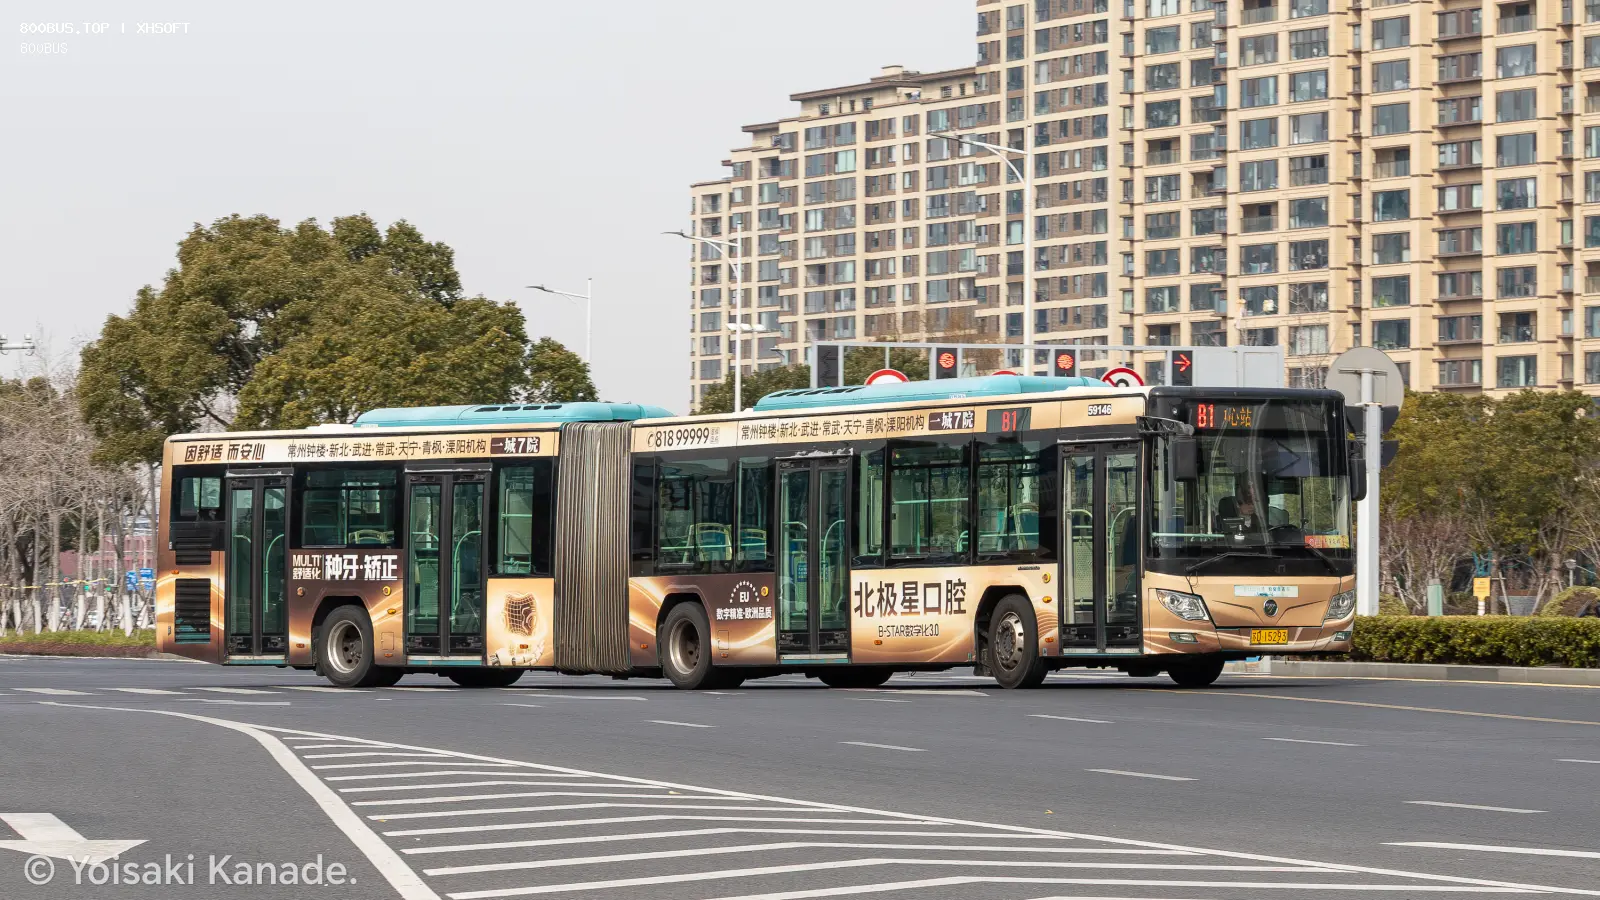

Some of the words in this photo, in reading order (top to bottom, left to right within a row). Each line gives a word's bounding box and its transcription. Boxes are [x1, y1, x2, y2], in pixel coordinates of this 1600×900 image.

[929, 410, 974, 429] 一城7院
[1088, 404, 1112, 416] 59146
[1198, 404, 1214, 428] B1
[1001, 411, 1017, 432] B1
[184, 444, 223, 463] 因舒适
[226, 443, 266, 461] 而安心
[491, 437, 539, 454] 一城7院
[292, 567, 321, 580] 舒适化
[325, 554, 398, 581] 种牙·矫正
[739, 591, 750, 603] EU
[854, 578, 967, 618] 北极星口腔
